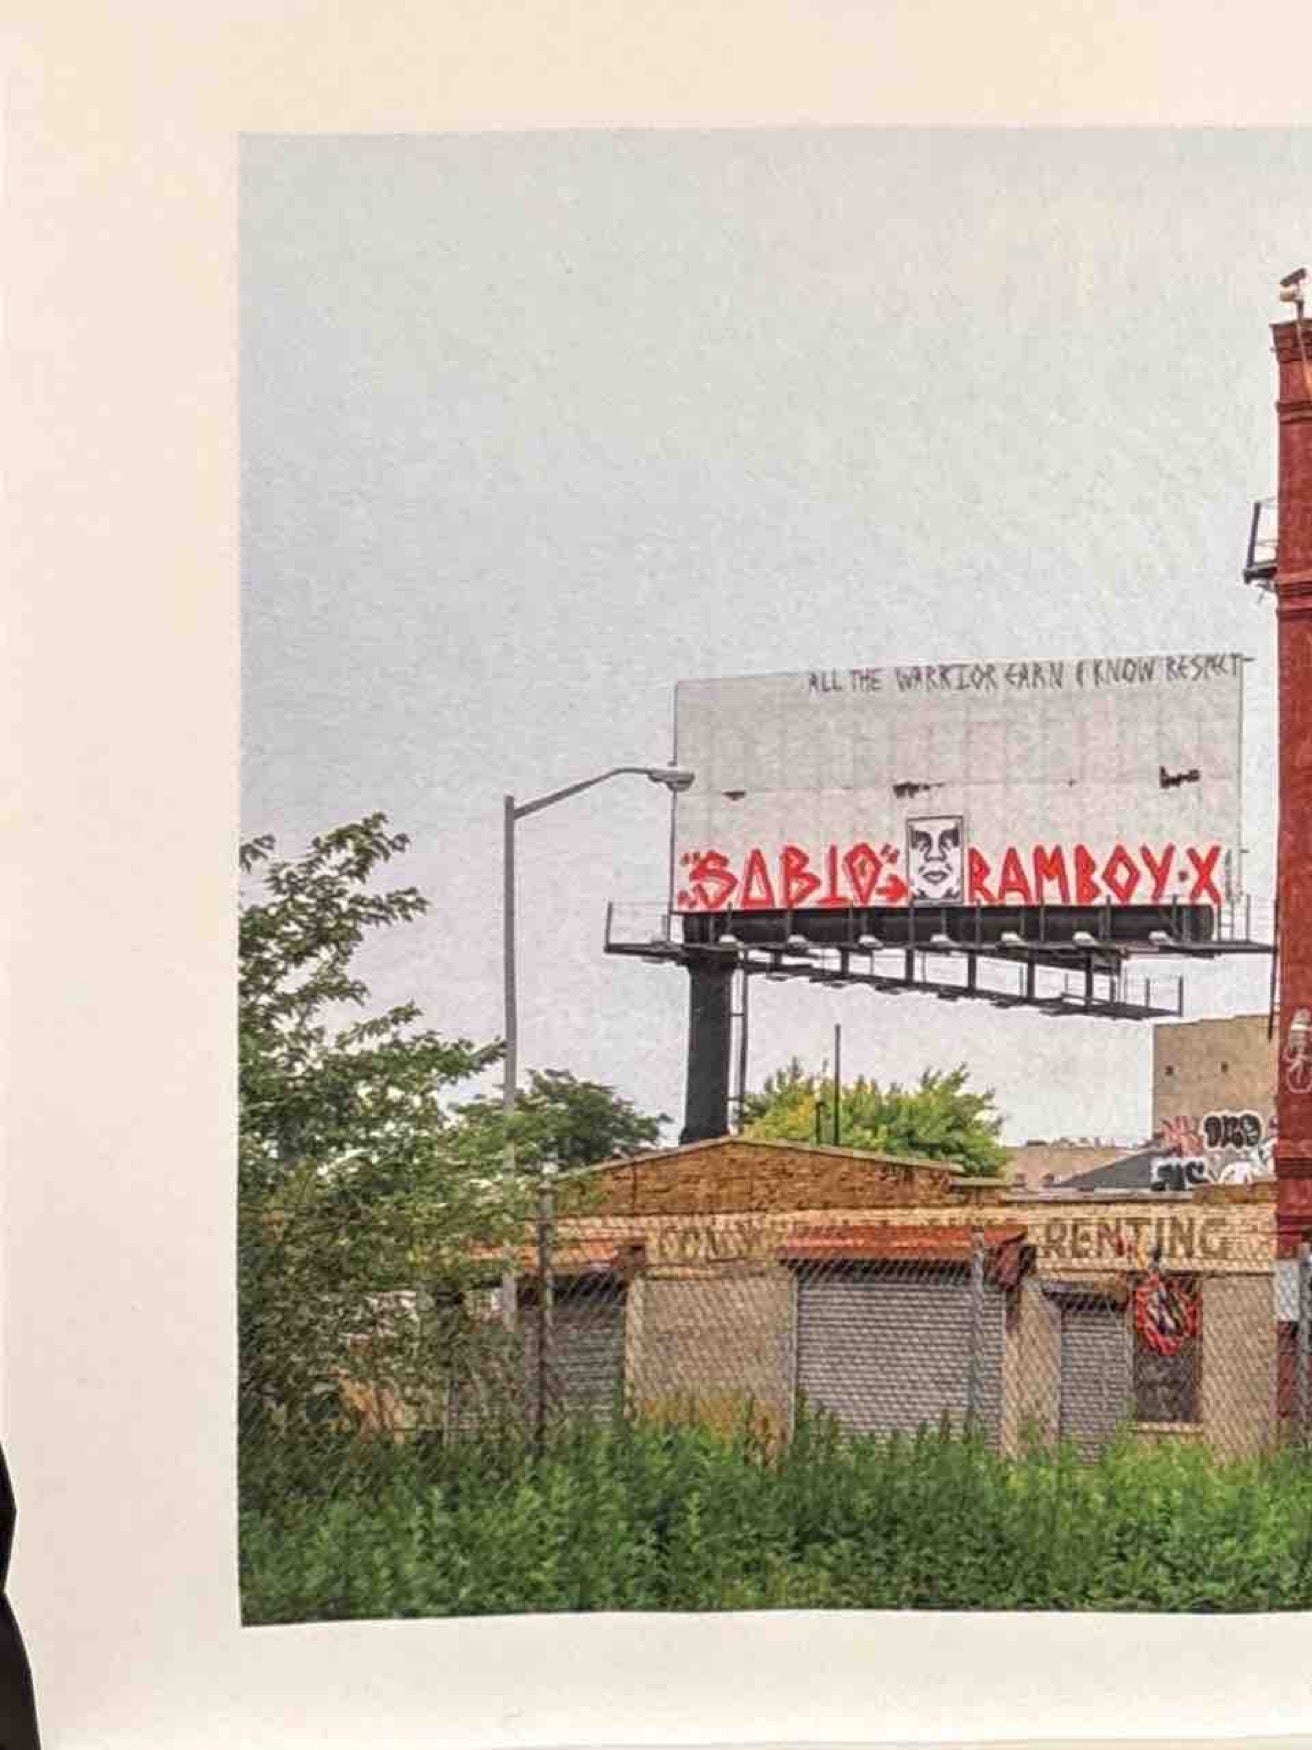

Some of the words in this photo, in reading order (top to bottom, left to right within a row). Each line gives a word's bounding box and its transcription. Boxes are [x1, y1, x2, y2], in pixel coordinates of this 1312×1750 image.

[807, 670, 842, 694] ALL
[850, 667, 881, 692] THE
[1004, 660, 1063, 690] EARN
[1094, 656, 1155, 686] KNOW
